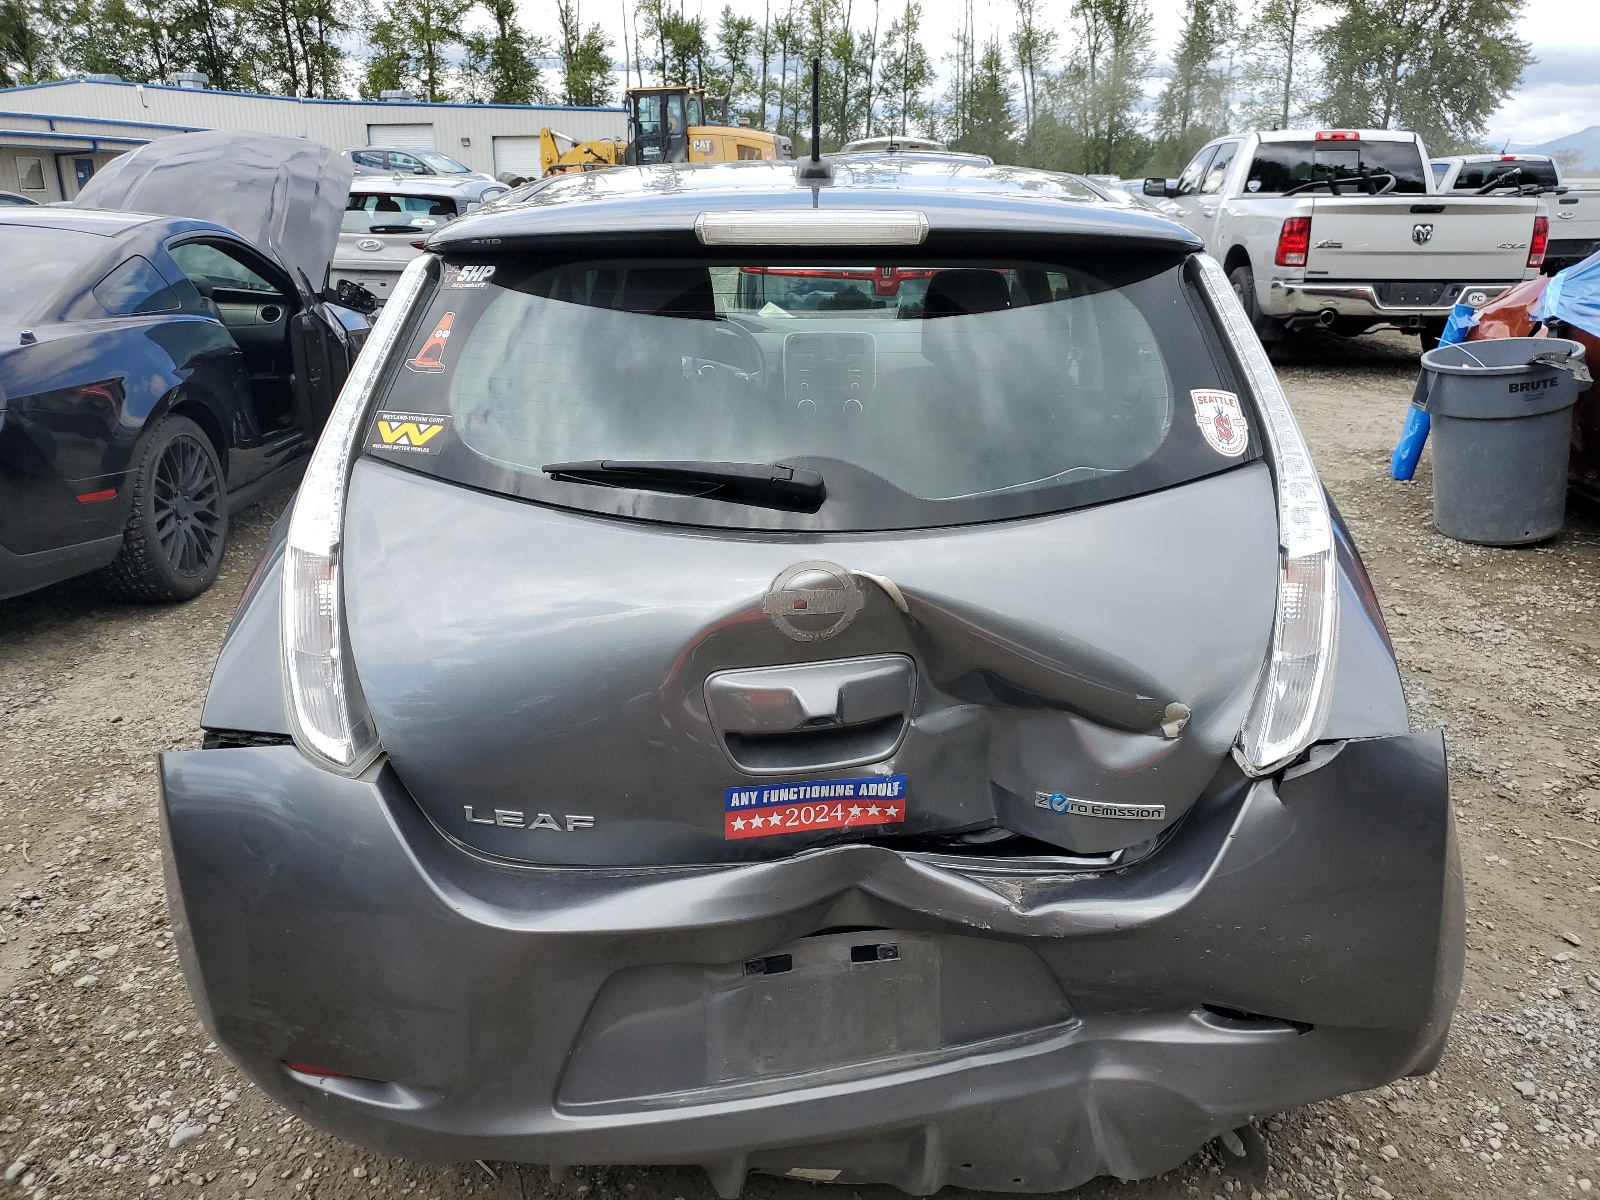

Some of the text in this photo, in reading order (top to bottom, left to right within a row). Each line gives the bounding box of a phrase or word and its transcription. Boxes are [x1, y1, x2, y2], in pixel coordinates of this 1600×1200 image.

[692, 139, 712, 153] CAT
[1471, 294, 1485, 303] PC
[1508, 376, 1559, 393] BRUTE
[1197, 395, 1236, 408] SEATTLE
[731, 781, 900, 807] ANY FUNCTIONING ADULT
[463, 805, 596, 832] LEAF
[785, 803, 844, 827] 2024
